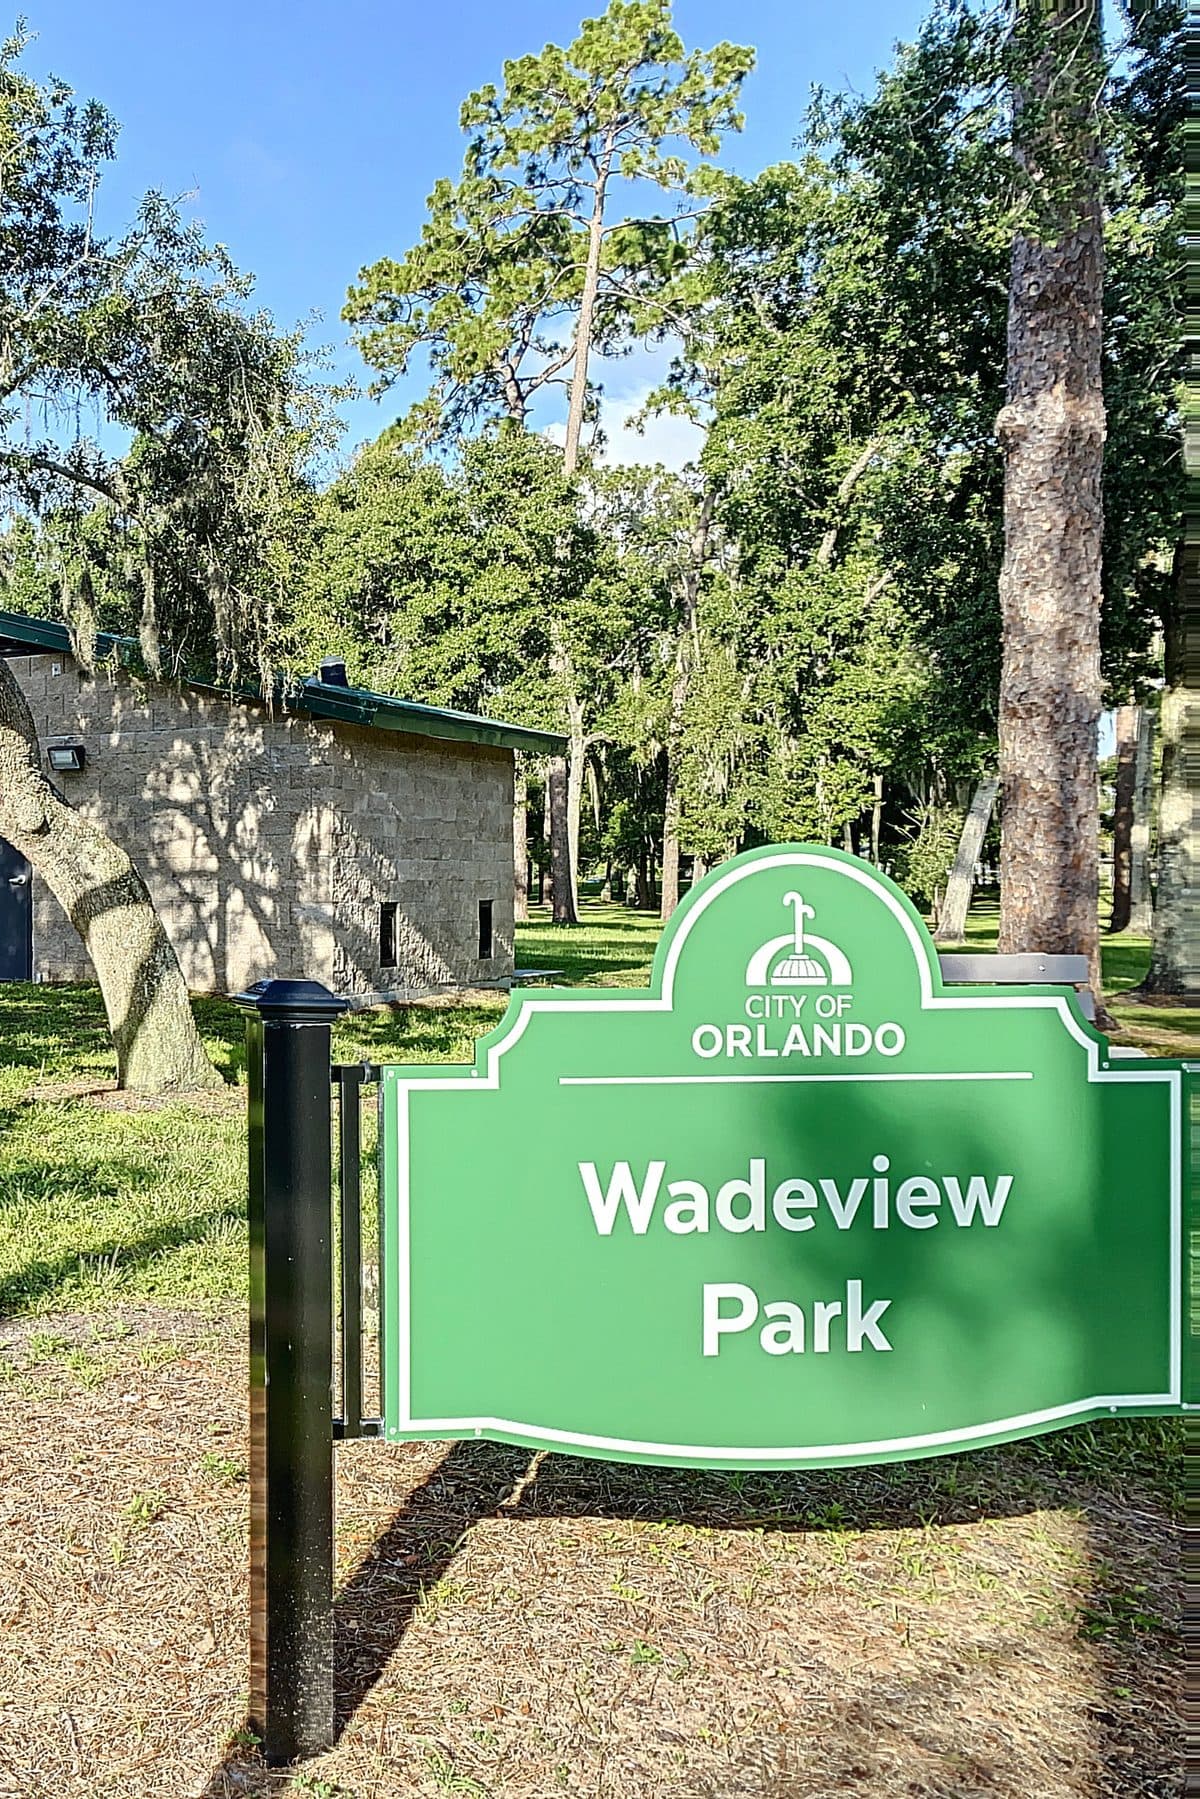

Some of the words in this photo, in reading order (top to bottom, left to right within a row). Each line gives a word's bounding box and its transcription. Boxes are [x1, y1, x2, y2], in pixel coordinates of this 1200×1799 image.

[744, 993, 809, 1019] CITY
[814, 993, 855, 1018] OF
[691, 1022, 906, 1059] ORLANDO
[577, 1155, 1015, 1236] Wadeview
[702, 1279, 893, 1357] Park
